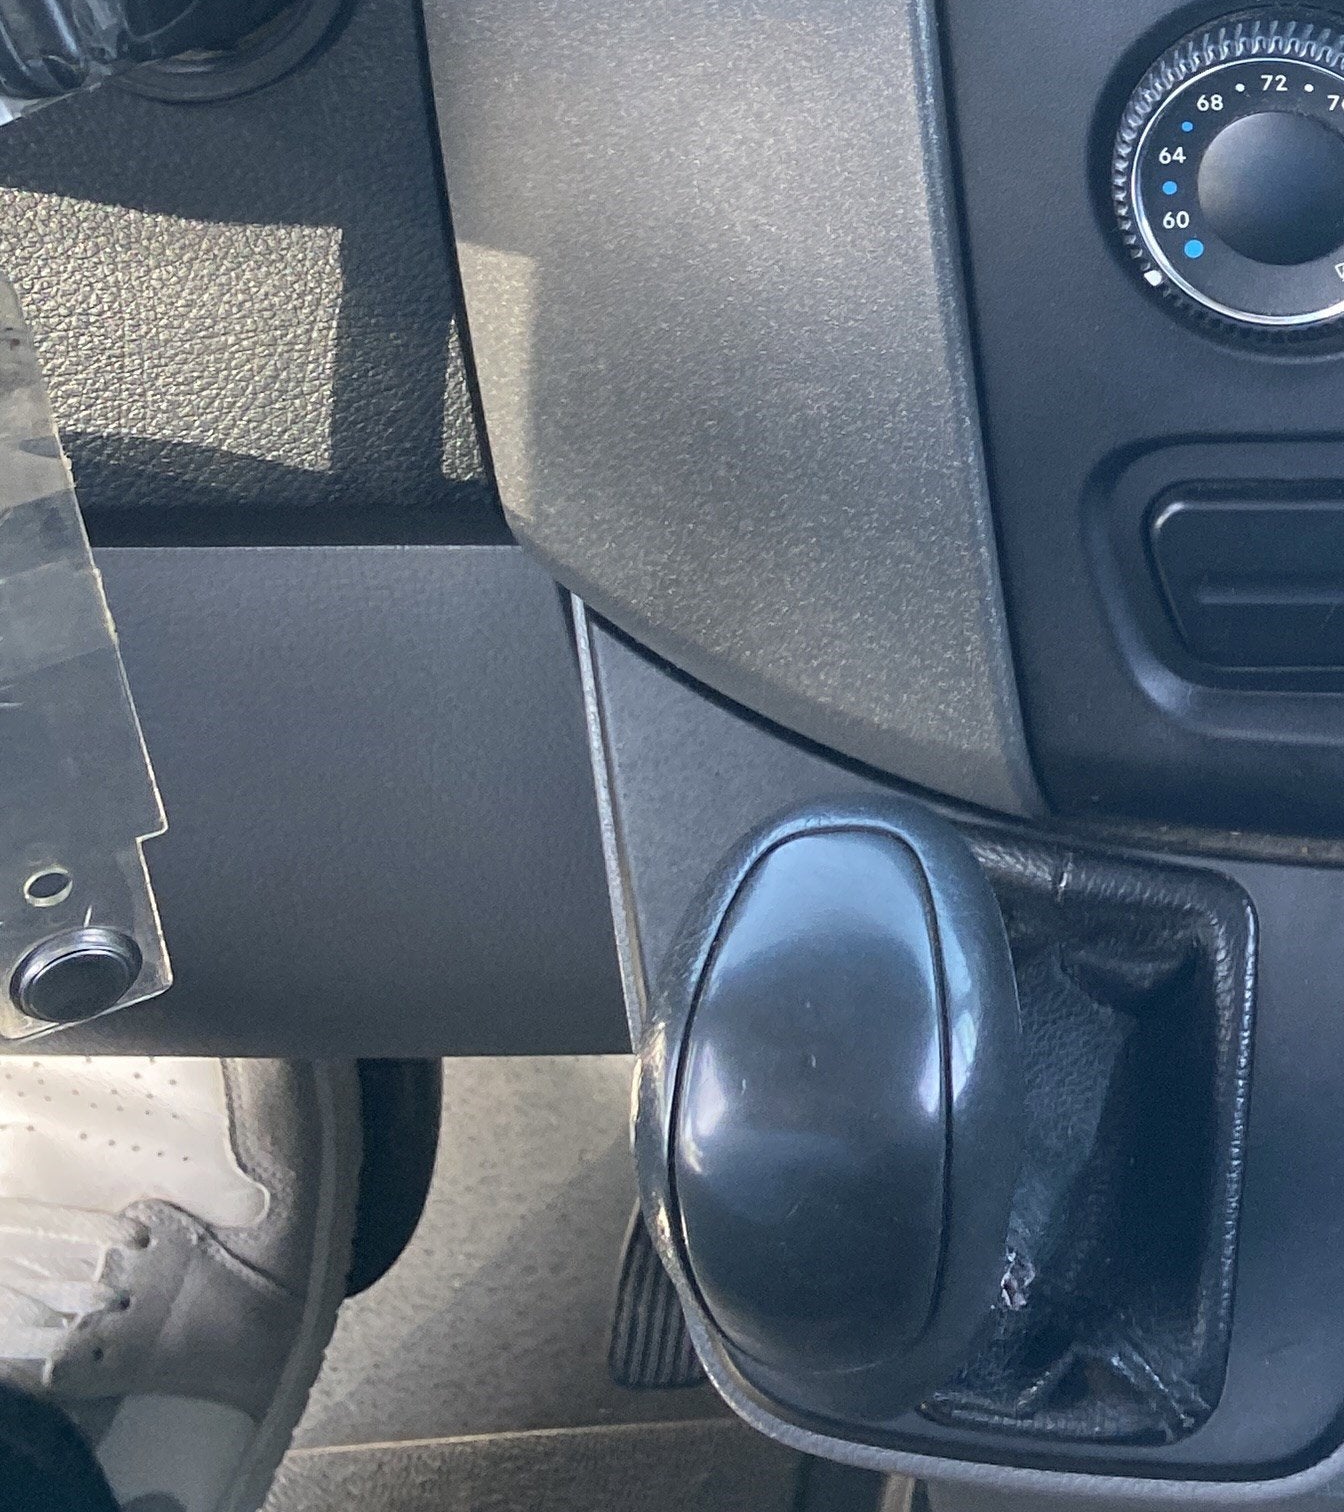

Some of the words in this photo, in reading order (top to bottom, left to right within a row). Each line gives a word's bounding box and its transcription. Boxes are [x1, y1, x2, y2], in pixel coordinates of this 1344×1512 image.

[1260, 73, 1289, 93] 72
[1196, 94, 1225, 113] 68
[1158, 146, 1188, 166] 64
[1162, 210, 1191, 230] 60
